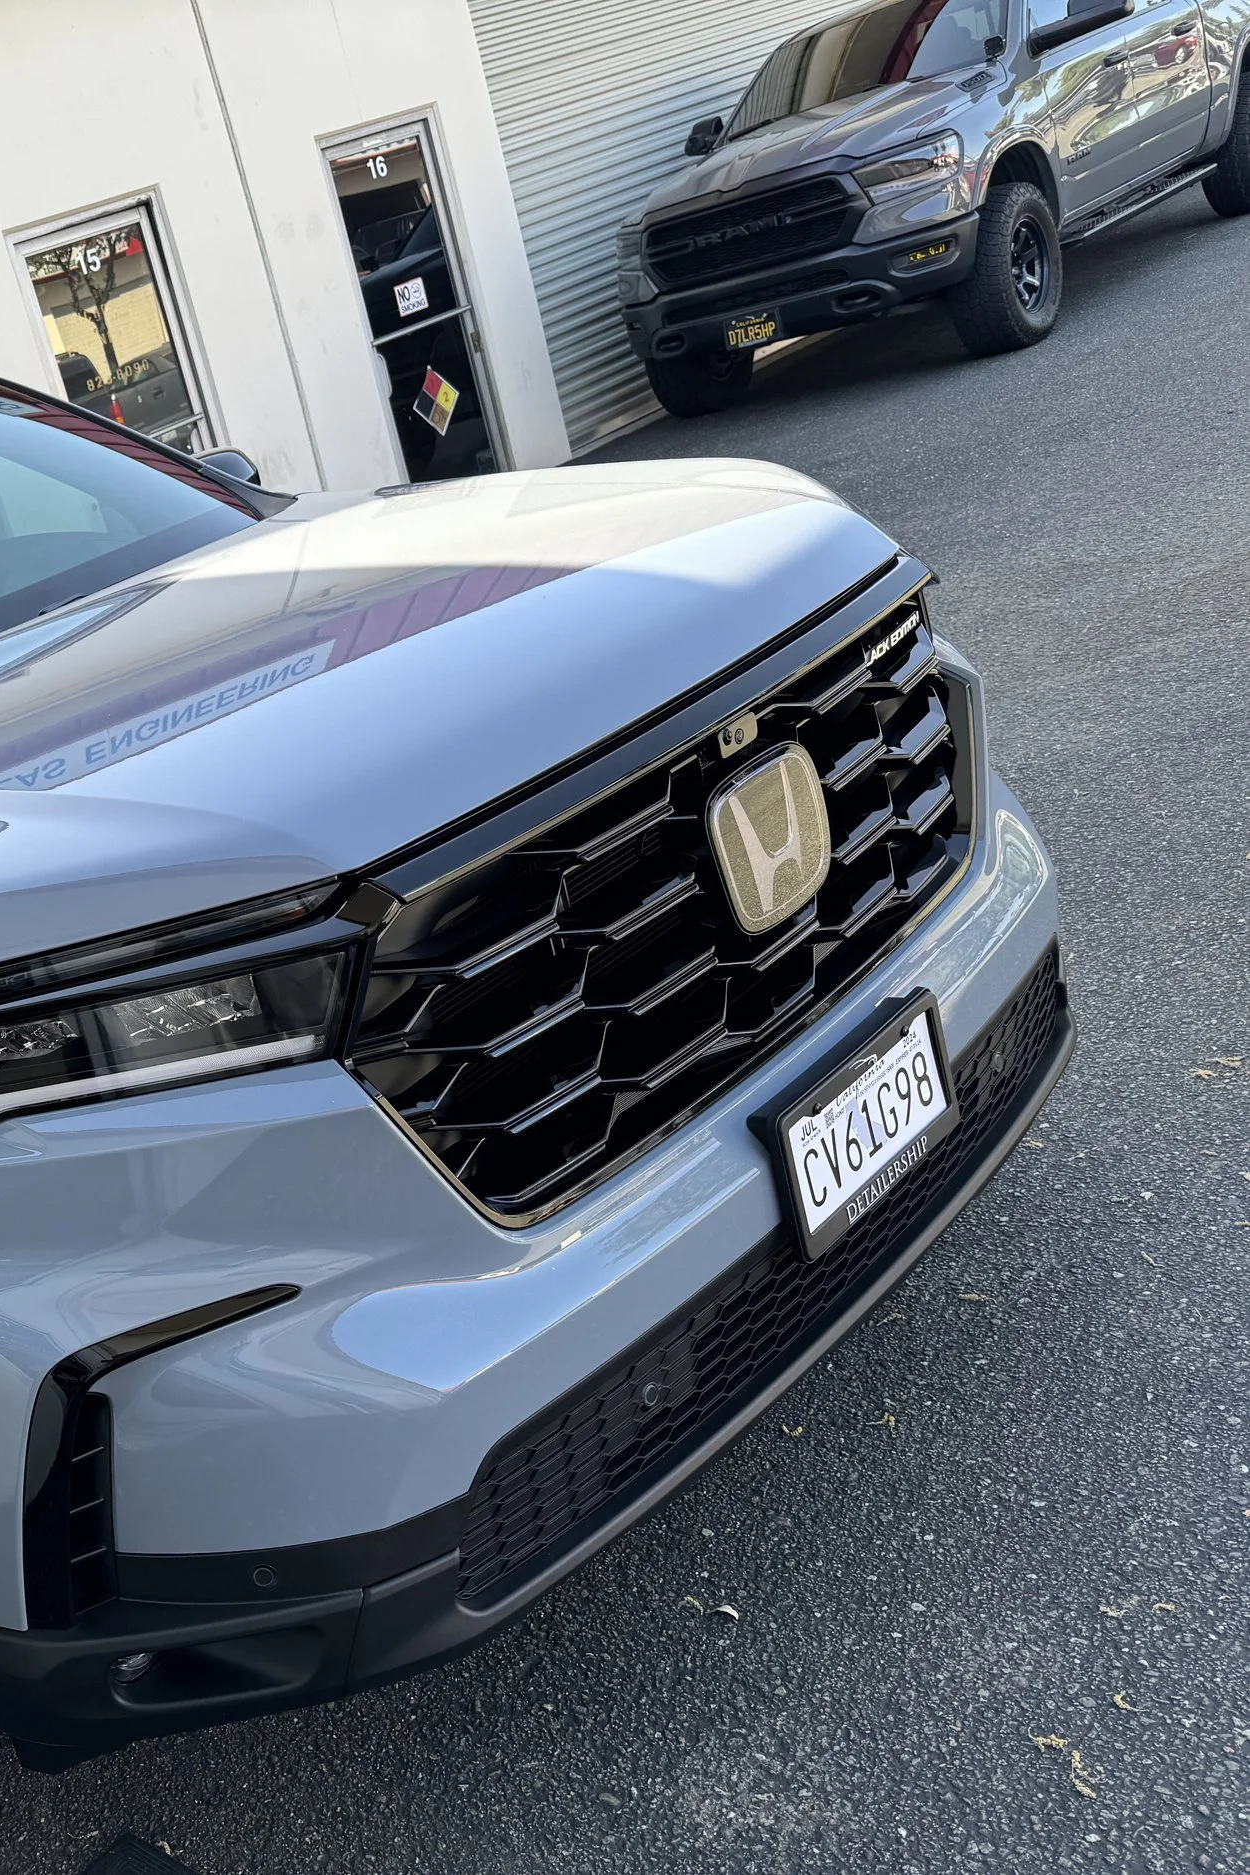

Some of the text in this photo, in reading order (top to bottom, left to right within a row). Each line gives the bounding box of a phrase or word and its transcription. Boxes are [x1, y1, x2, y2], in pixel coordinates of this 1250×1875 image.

[366, 155, 388, 179] 16
[695, 215, 779, 247] RAM
[76, 248, 102, 275] 15
[396, 286, 411, 305] NO
[401, 298, 426, 314] SMOKING
[728, 321, 776, 346] D7LR5HP
[902, 1030, 917, 1049] 2024
[801, 1118, 818, 1142] JUL
[803, 1051, 934, 1208] CV61G98
[845, 1135, 929, 1224] DETAILERSHIP
